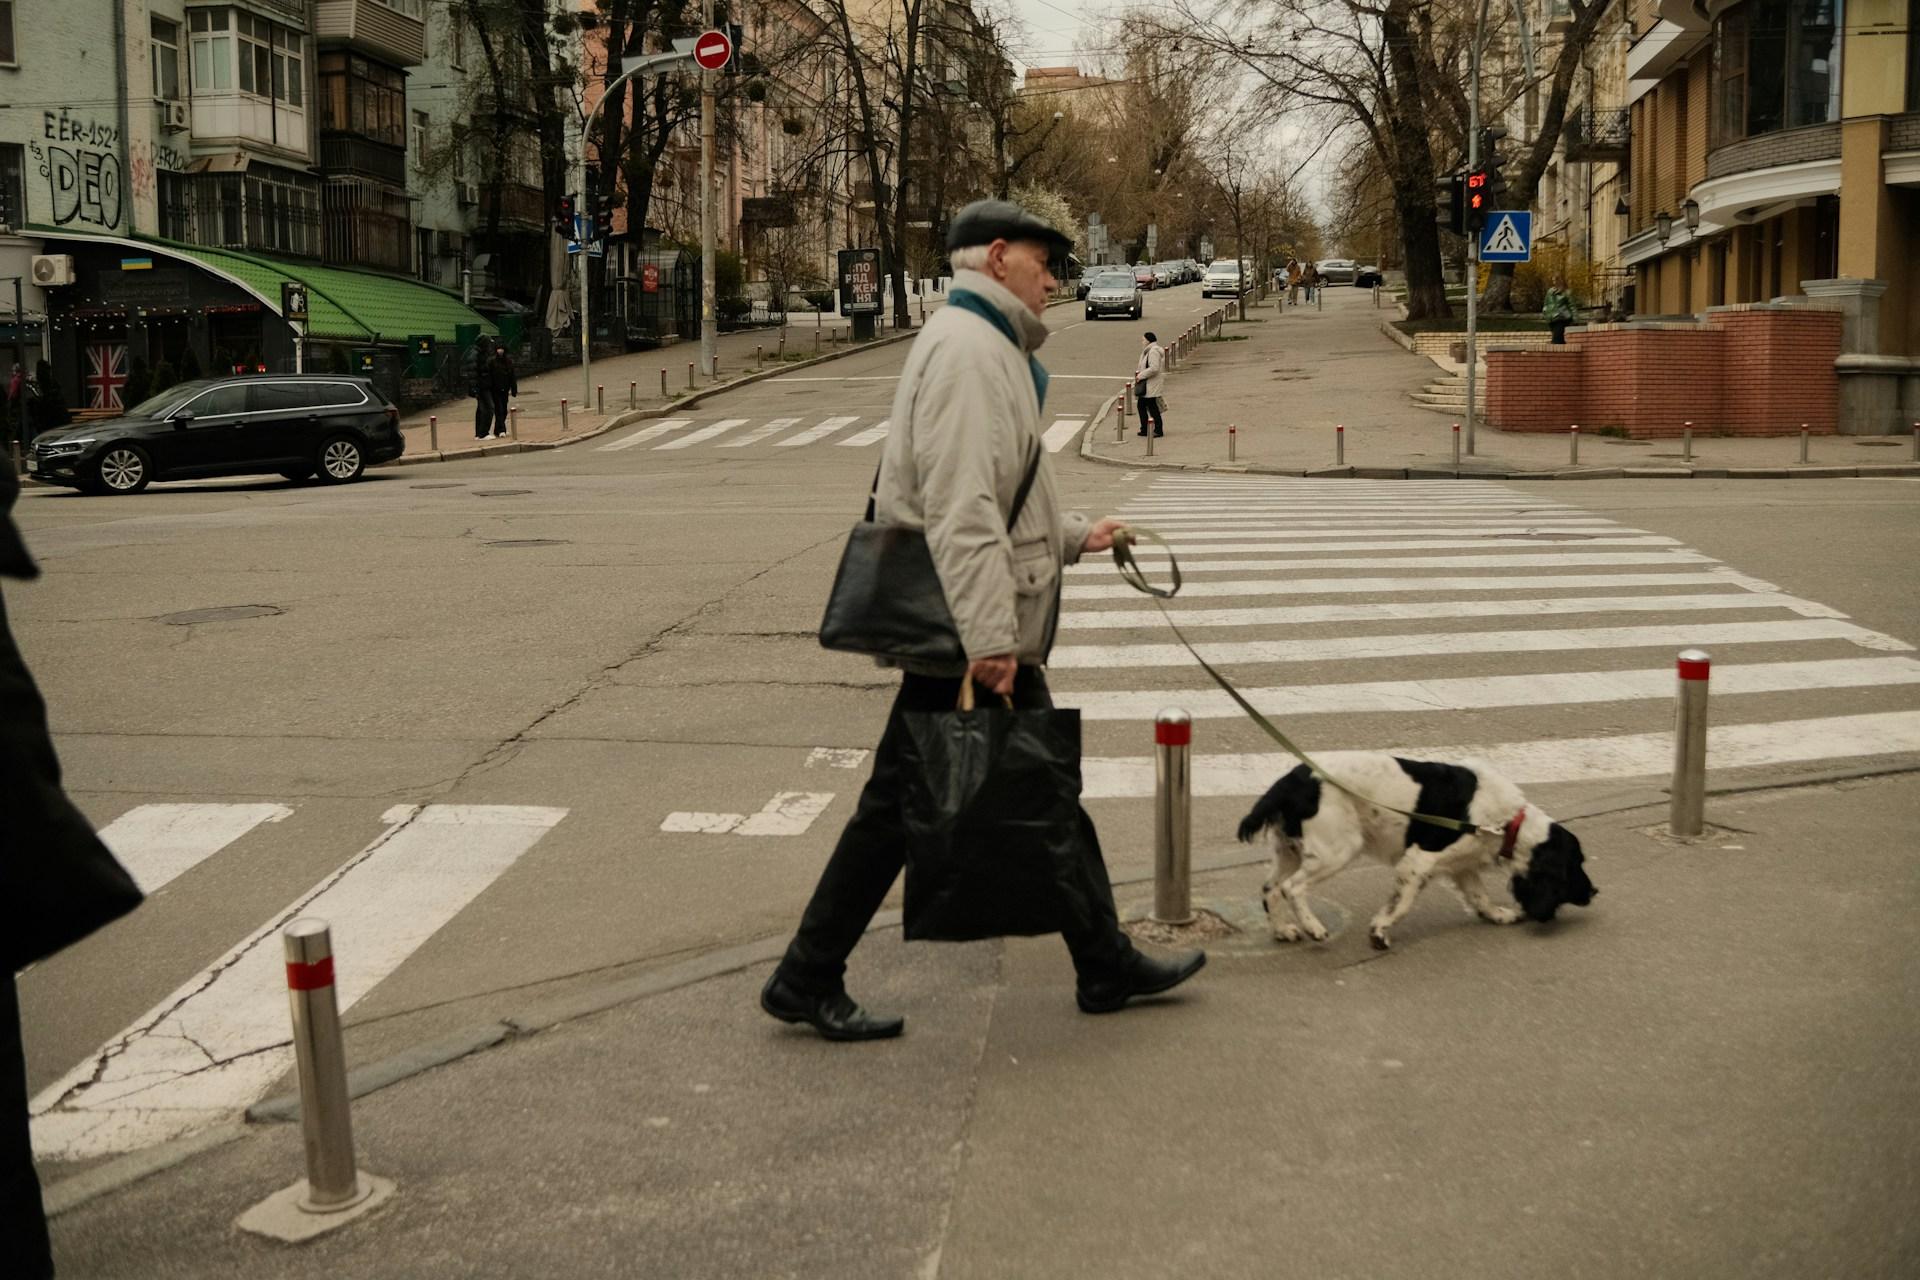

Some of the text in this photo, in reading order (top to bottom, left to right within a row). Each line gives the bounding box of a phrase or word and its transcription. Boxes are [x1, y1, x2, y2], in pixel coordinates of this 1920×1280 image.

[48, 146, 121, 230] DEO
[845, 273, 869, 284] РЯД
[853, 283, 878, 294] ЖЕН
[856, 293, 872, 303] НЯ
